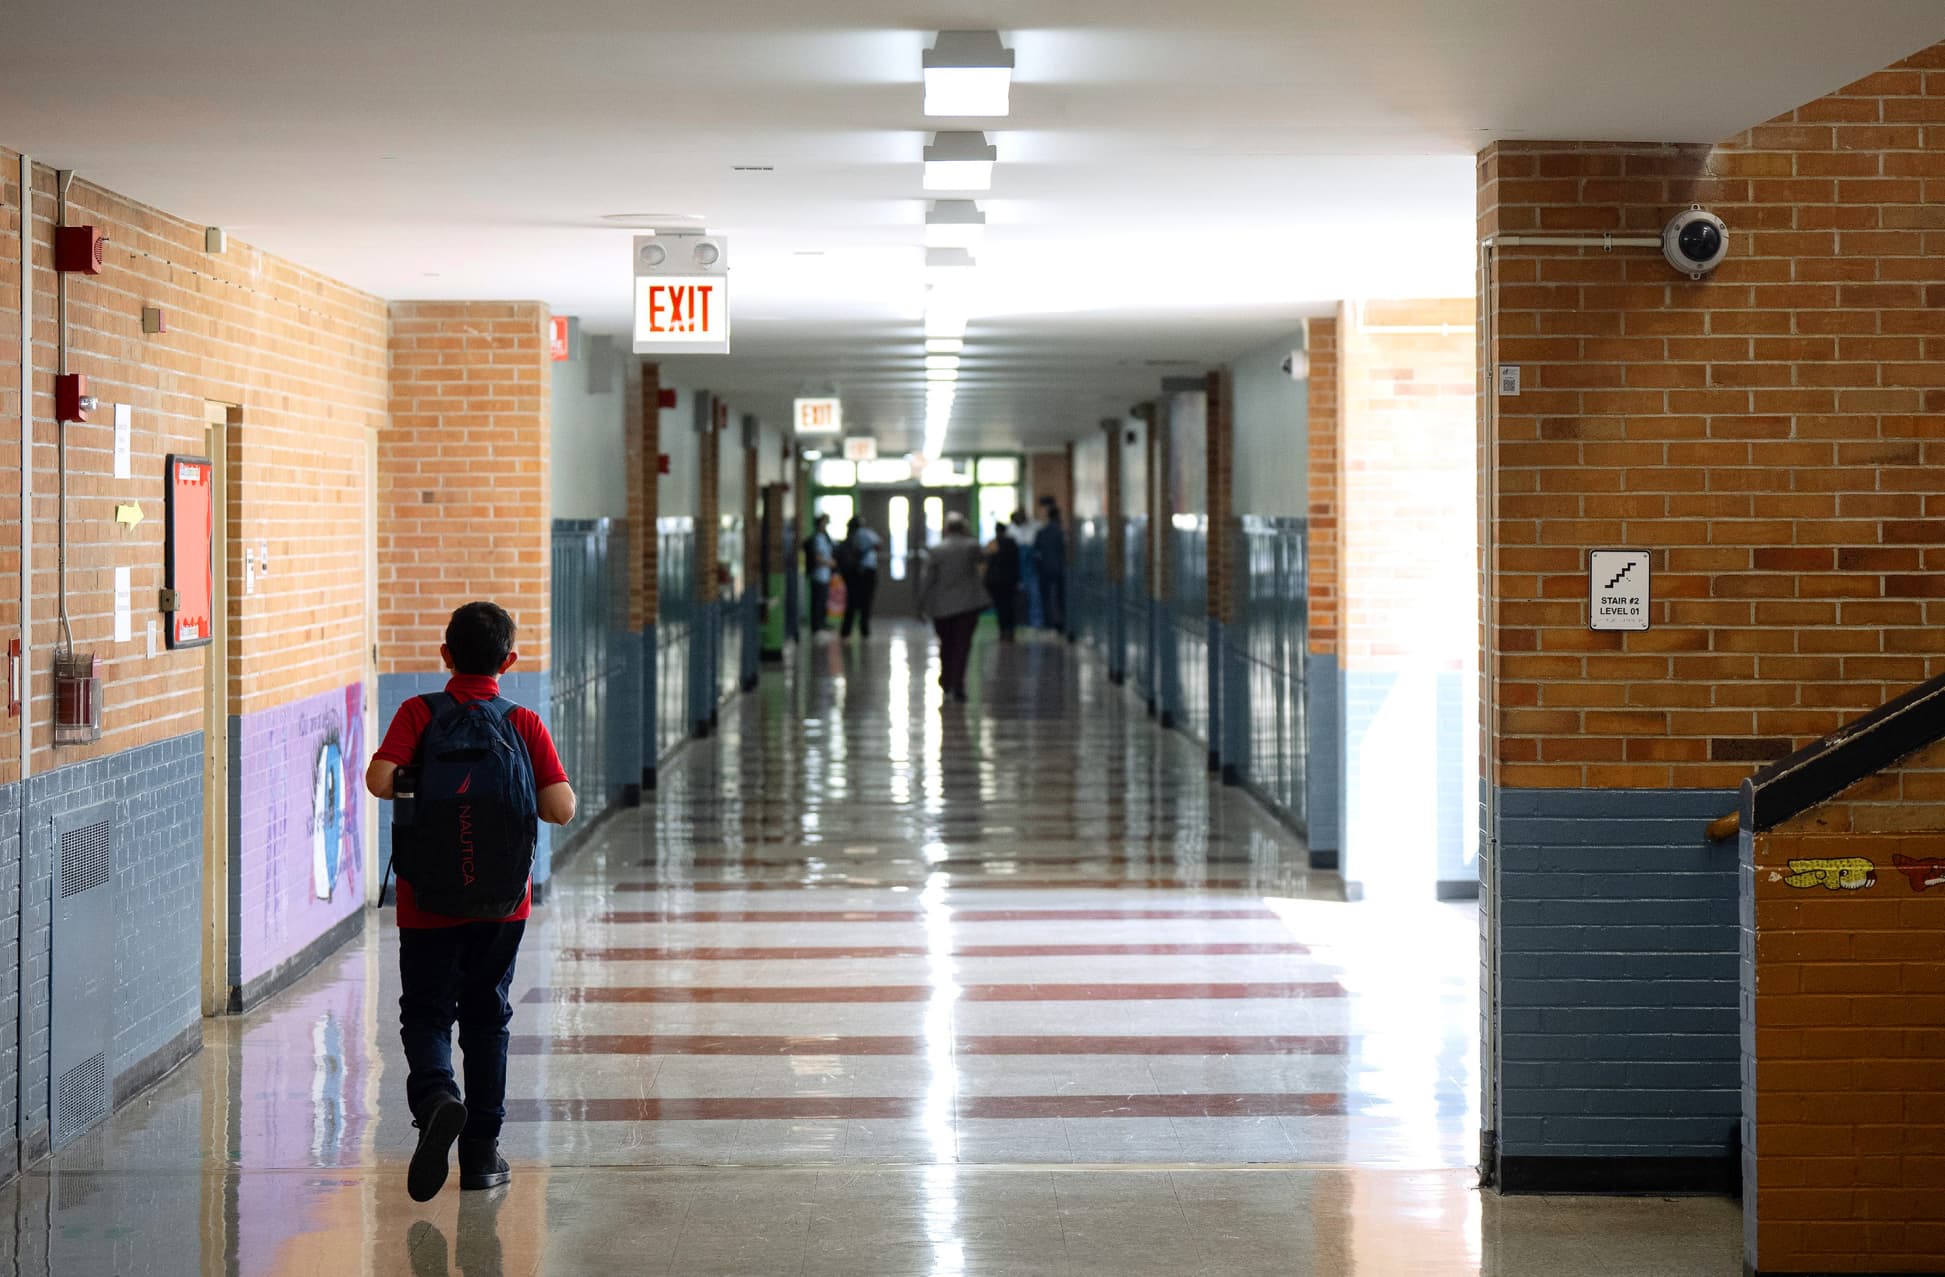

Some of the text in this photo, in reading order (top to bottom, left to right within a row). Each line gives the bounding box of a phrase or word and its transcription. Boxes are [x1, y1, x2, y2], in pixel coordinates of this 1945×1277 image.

[649, 286, 713, 332] EXIT
[801, 403, 832, 426] EXIT
[1600, 607, 1639, 615] LEVEL 01
[1601, 597, 1639, 605] STAIR #2
[458, 805, 475, 886] NAUTICA
